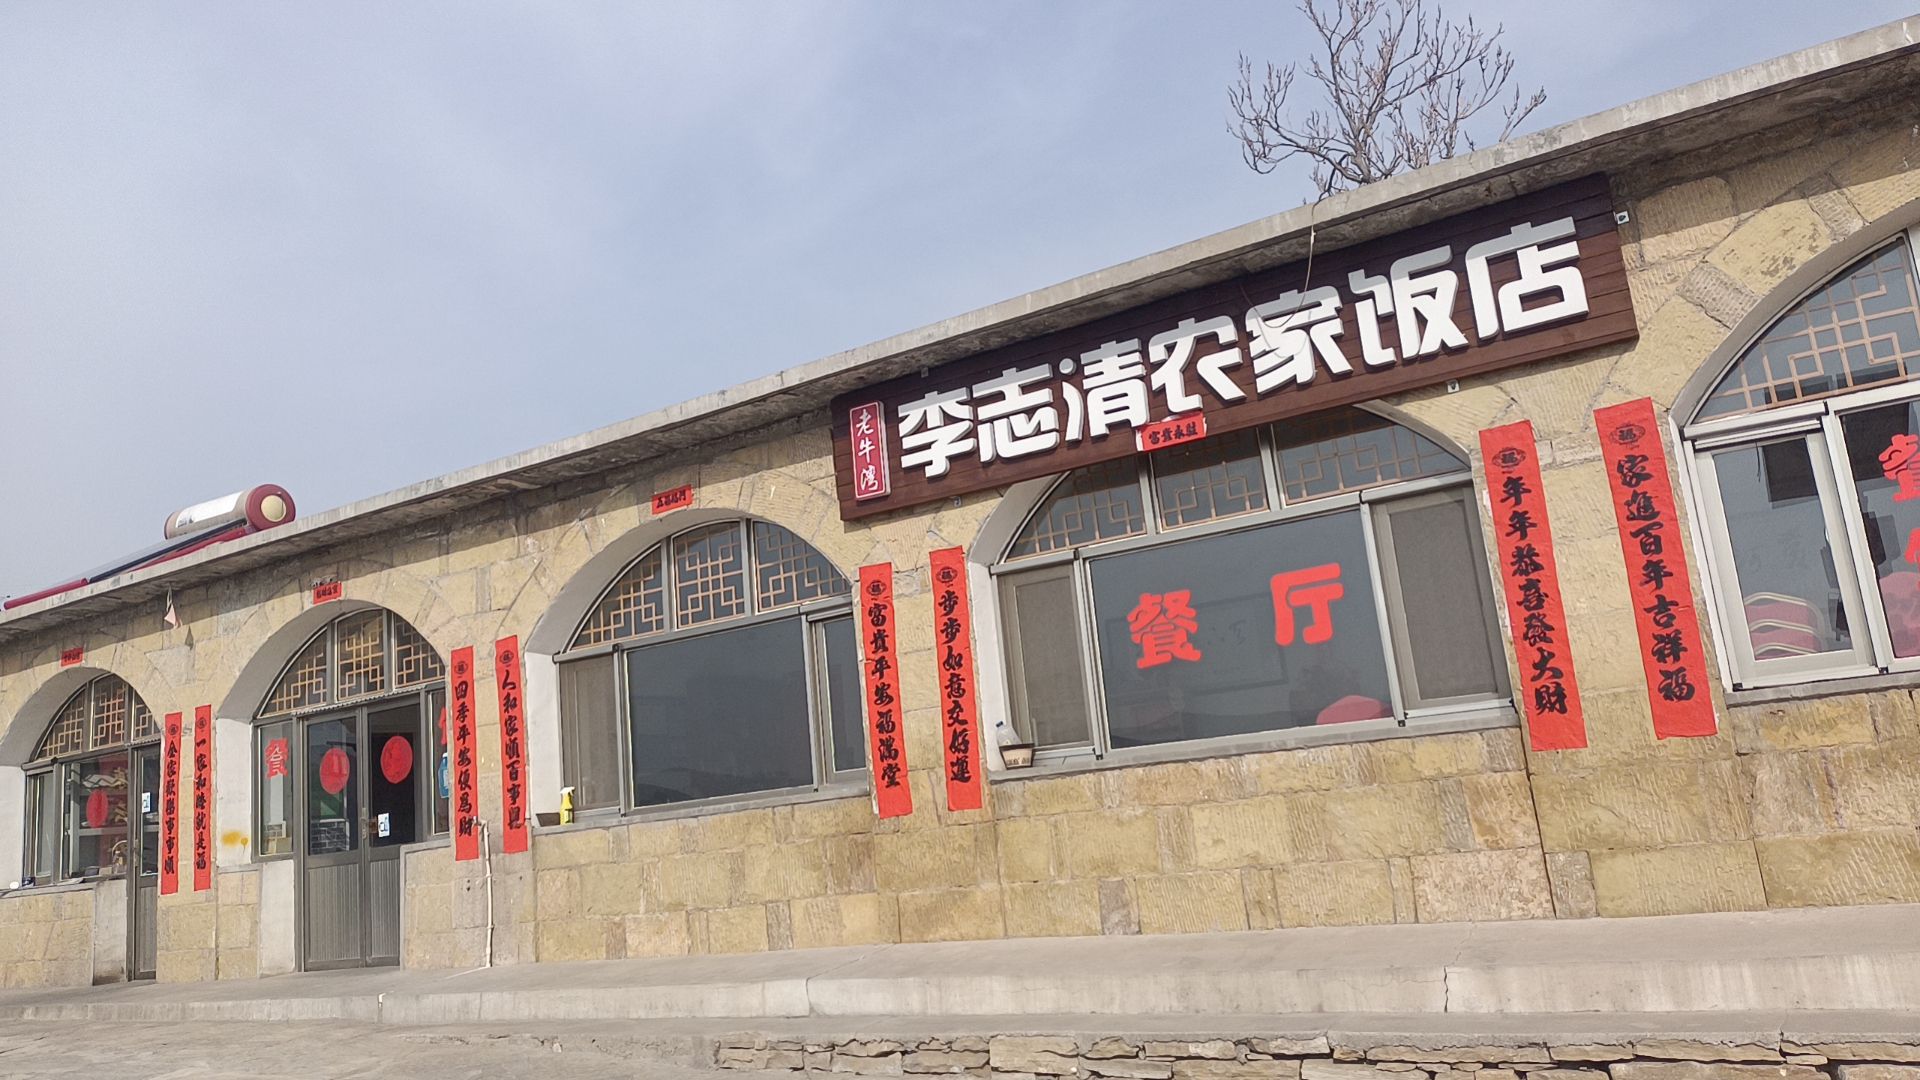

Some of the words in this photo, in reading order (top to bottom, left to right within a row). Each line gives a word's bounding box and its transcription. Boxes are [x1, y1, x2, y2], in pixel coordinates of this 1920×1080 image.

[898, 216, 1589, 477] 李志清农家饭店
[1127, 562, 1344, 669] 餐厅
[1500, 475, 1568, 716] 年年恭喜發大財
[1616, 453, 1696, 703] 家進百年吉祥福
